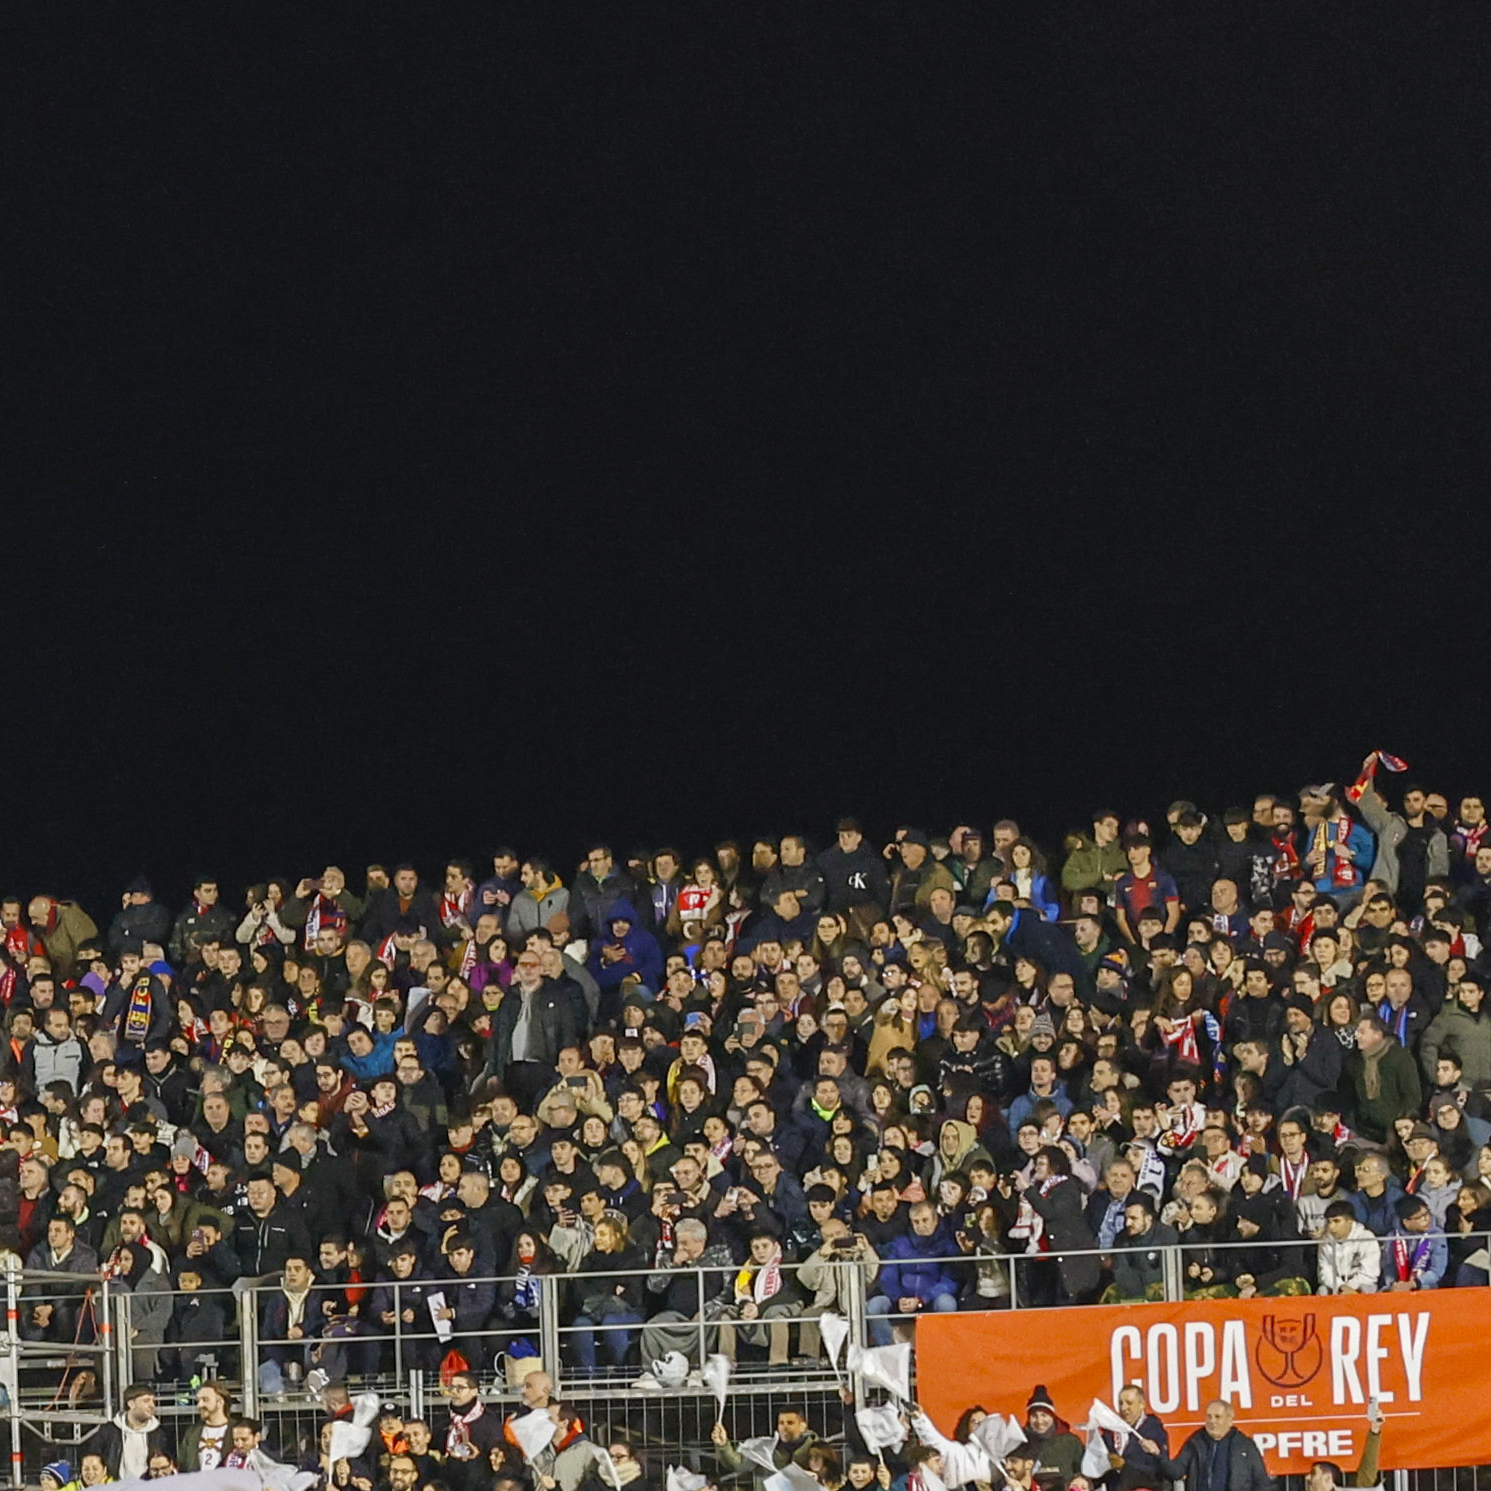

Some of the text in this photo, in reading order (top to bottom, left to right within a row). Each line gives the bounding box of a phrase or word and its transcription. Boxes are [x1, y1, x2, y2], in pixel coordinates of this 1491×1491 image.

[1270, 1395, 1314, 1408] DEL
[1329, 1312, 1431, 1406] REY
[1254, 1429, 1354, 1458] PFRE
